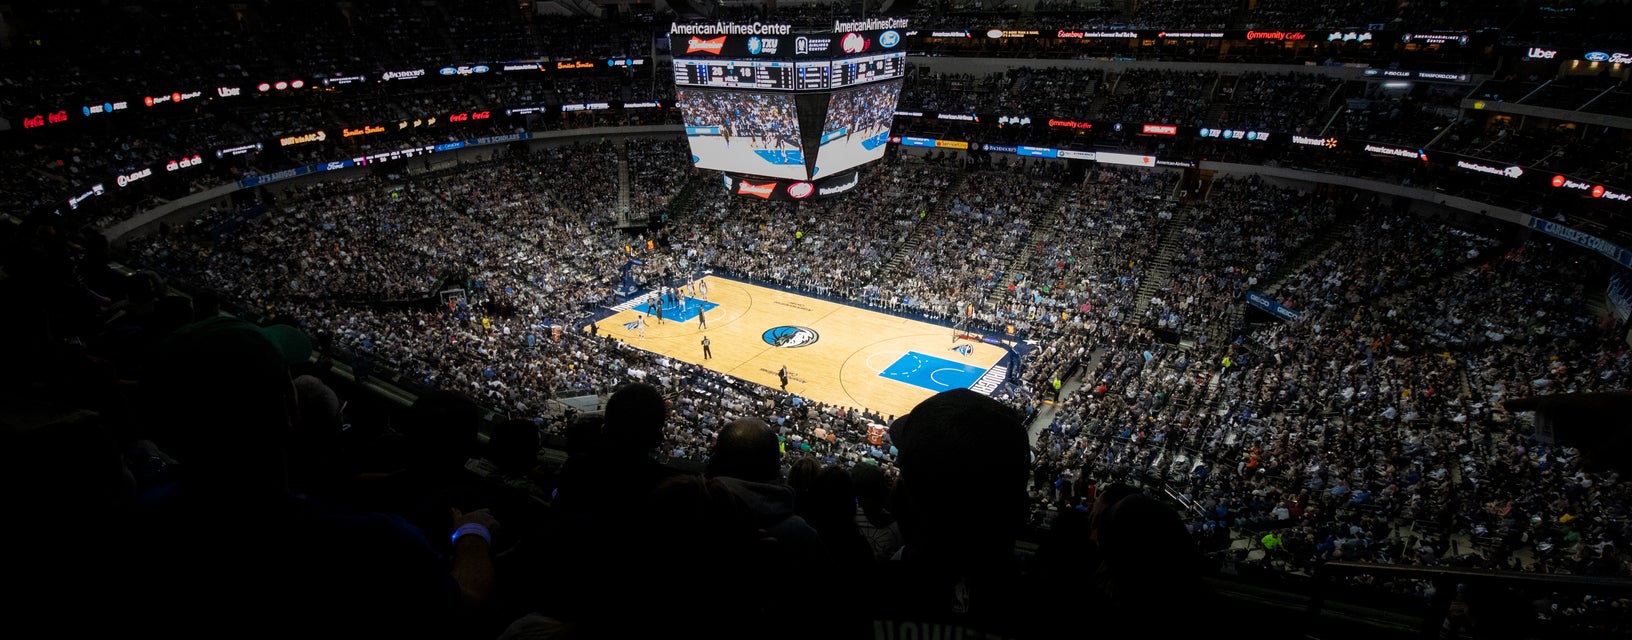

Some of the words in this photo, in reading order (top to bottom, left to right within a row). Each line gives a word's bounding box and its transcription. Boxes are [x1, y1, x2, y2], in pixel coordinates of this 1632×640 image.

[670, 22, 792, 35] AmericanAirlinesCenter
[834, 17, 909, 33] AmericanAirlinesCenter
[1247, 31, 1285, 40] Community
[1285, 32, 1306, 40] Coffee
[761, 39, 778, 48] TXU
[1528, 47, 1557, 58] Uber
[457, 66, 473, 75] Ford
[218, 87, 240, 97] Uber
[1049, 119, 1077, 128] Community
[1292, 136, 1325, 146] Walmart
[1364, 144, 1394, 155] American
[1394, 149, 1418, 158] Airlines
[327, 161, 344, 170] Ford
[271, 168, 296, 180] AMIGOS
[1544, 221, 1588, 244] CARLISLE'S
[1586, 235, 1617, 256] CORNER
